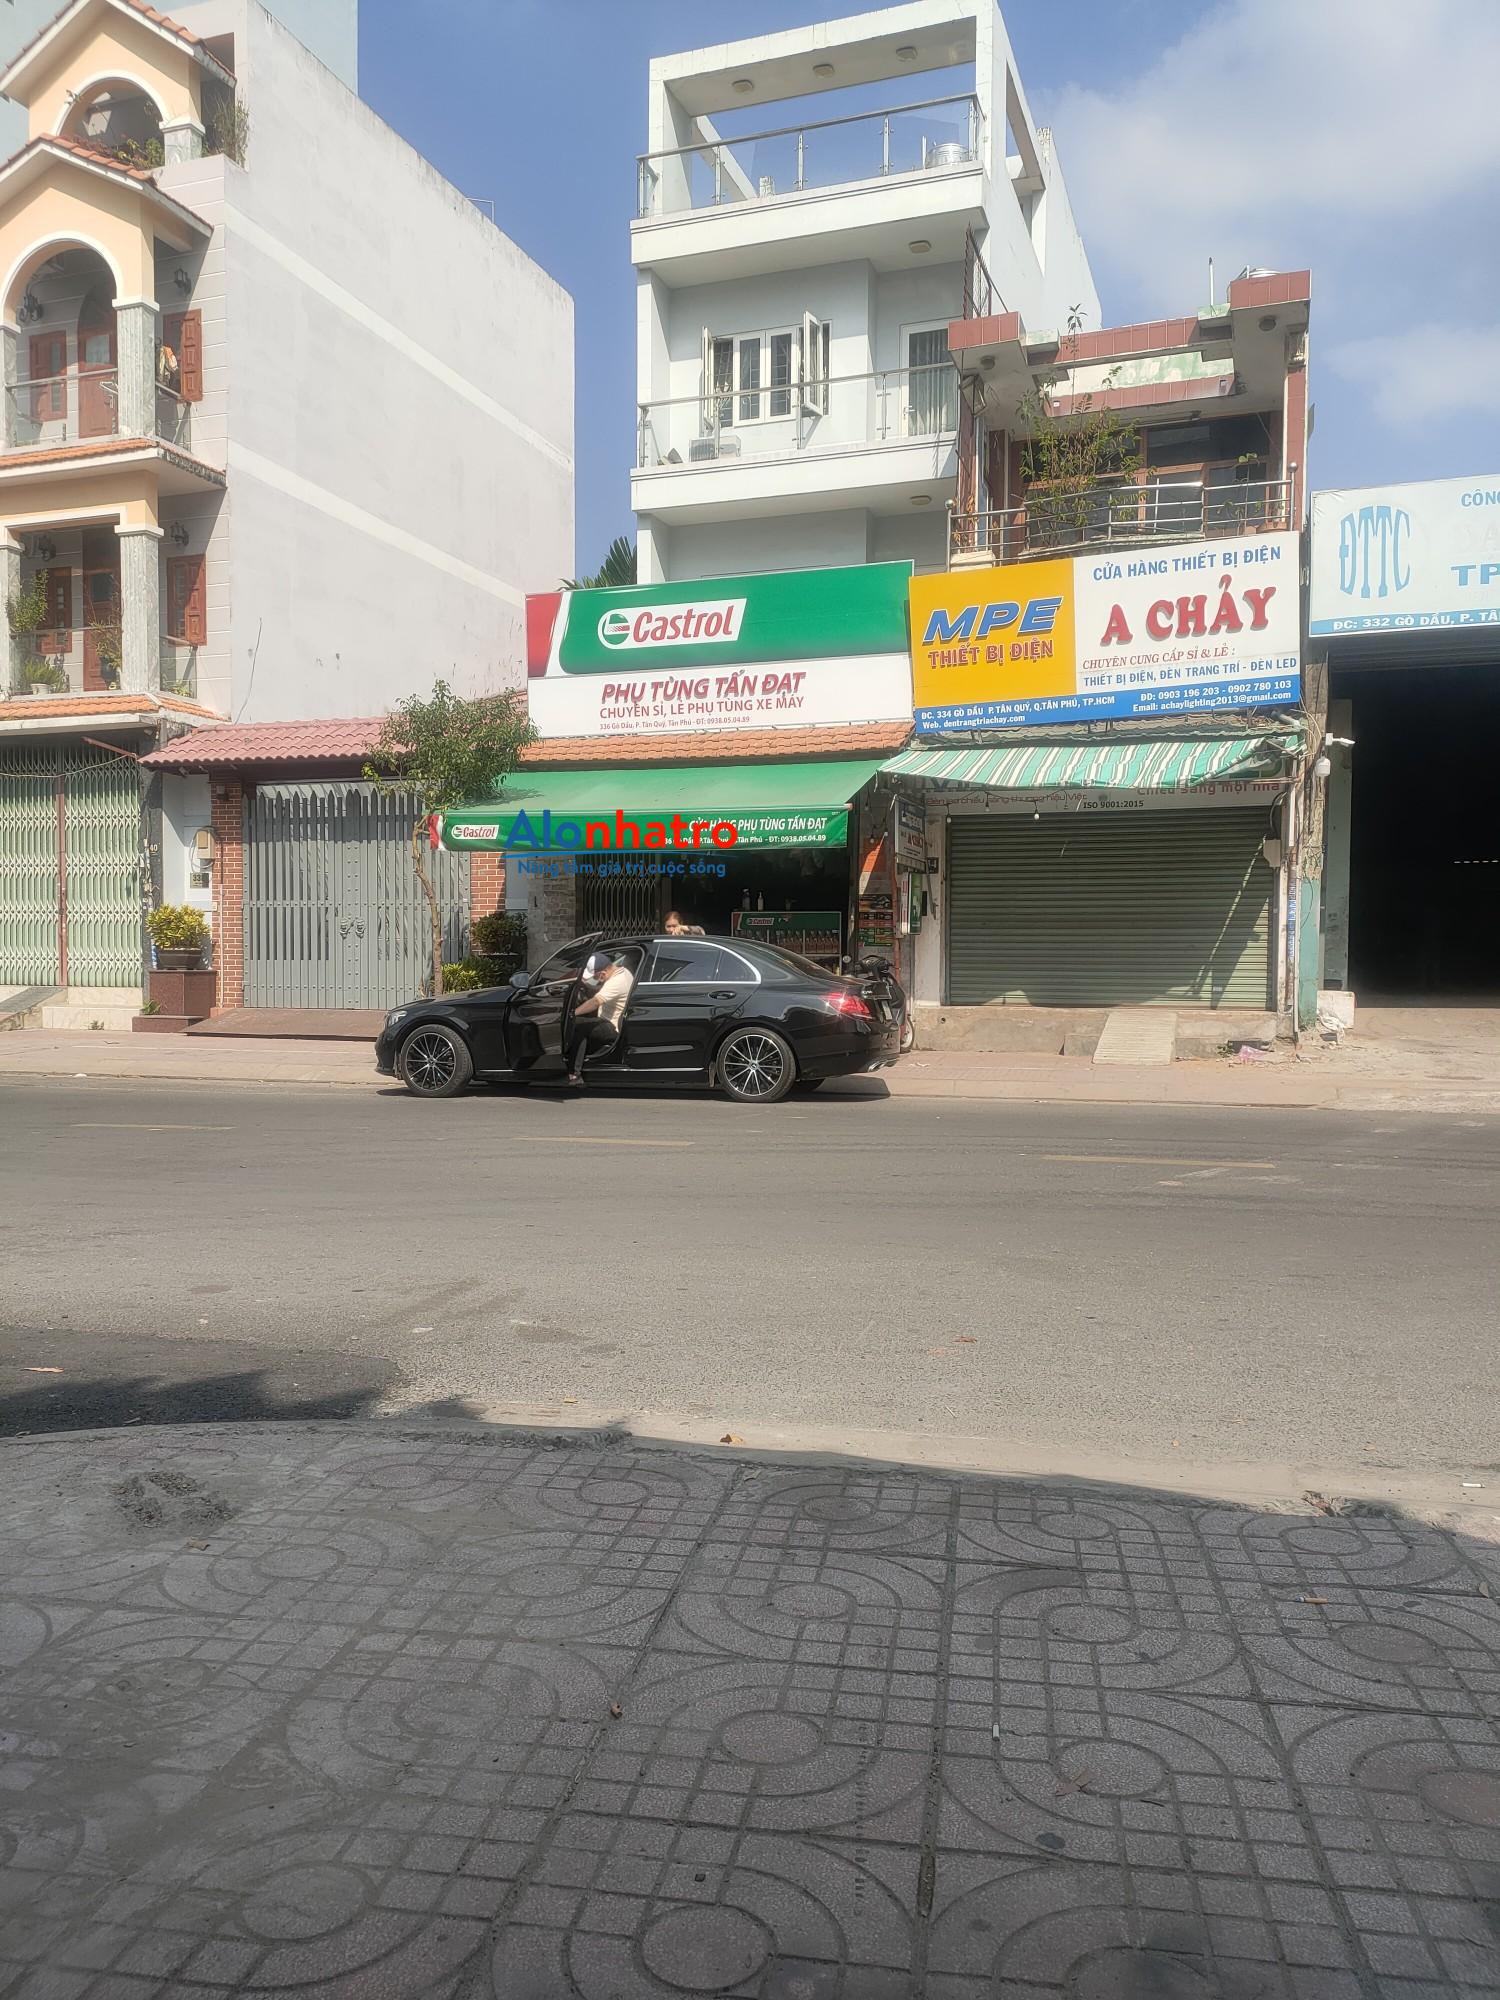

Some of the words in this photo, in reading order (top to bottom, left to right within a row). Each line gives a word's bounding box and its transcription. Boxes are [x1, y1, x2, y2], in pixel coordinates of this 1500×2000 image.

[1461, 489, 1500, 507] CÔN
[1093, 562, 1122, 581] CỬA
[1128, 560, 1168, 577] HÀNG
[1172, 550, 1217, 572] THIẾT
[1223, 552, 1238, 568] BỊ
[1243, 545, 1281, 564] ĐIỆN
[922, 596, 1064, 646] MPE
[1100, 604, 1133, 646] A
[1146, 574, 1277, 641] CHẢY
[1362, 617, 1390, 627] 332
[1394, 614, 1414, 626] GÒ
[1460, 613, 1474, 622] P.
[1478, 609, 1500, 621] TÂ
[633, 605, 734, 643] Castrol
[928, 642, 979, 669] THIẾT
[986, 644, 1004, 665] BỊ
[1011, 638, 1053, 662] ĐIỆN
[1083, 656, 1127, 669] CHUYÊN
[1130, 654, 1159, 664] CUNG
[1162, 648, 1184, 661] CẤP
[1201, 648, 1211, 658] &
[1084, 672, 1112, 686] THIẾT
[1116, 674, 1126, 685] BỊ
[1160, 667, 1181, 680] ĐÈN
[1185, 665, 1220, 677] TRANG
[1223, 660, 1240, 674] TRÍ
[1250, 658, 1272, 671] ĐÈN
[1276, 658, 1297, 669] LED
[602, 682, 646, 707] PHỤ
[651, 676, 710, 701] TÙNG
[715, 669, 758, 697] TẤN
[762, 672, 806, 699] ĐẠT
[1158, 690, 1180, 700] 0903
[1183, 688, 1200, 698] 196
[1202, 686, 1220, 697] 203
[1228, 684, 1251, 694] 0902
[1253, 681, 1271, 691] 780
[1274, 680, 1292, 690] 103
[688, 702, 714, 716] PHỤ
[717, 697, 753, 712] TÙNG
[757, 698, 772, 710] XE
[776, 694, 804, 709] MÁY
[936, 710, 952, 719] 334
[1082, 696, 1115, 706] TP.HCM
[1132, 702, 1158, 712] Email:
[1161, 692, 1292, 710] achaylighting2013@gmail.com
[1083, 801, 1098, 809] ISO
[1100, 800, 1144, 809] 9001:2015
[463, 826, 496, 838] Castrol
[737, 819, 758, 834] PHỤ
[760, 816, 786, 831] TÙNG
[787, 814, 808, 830] TẤN
[807, 817, 828, 832] ĐẠT
